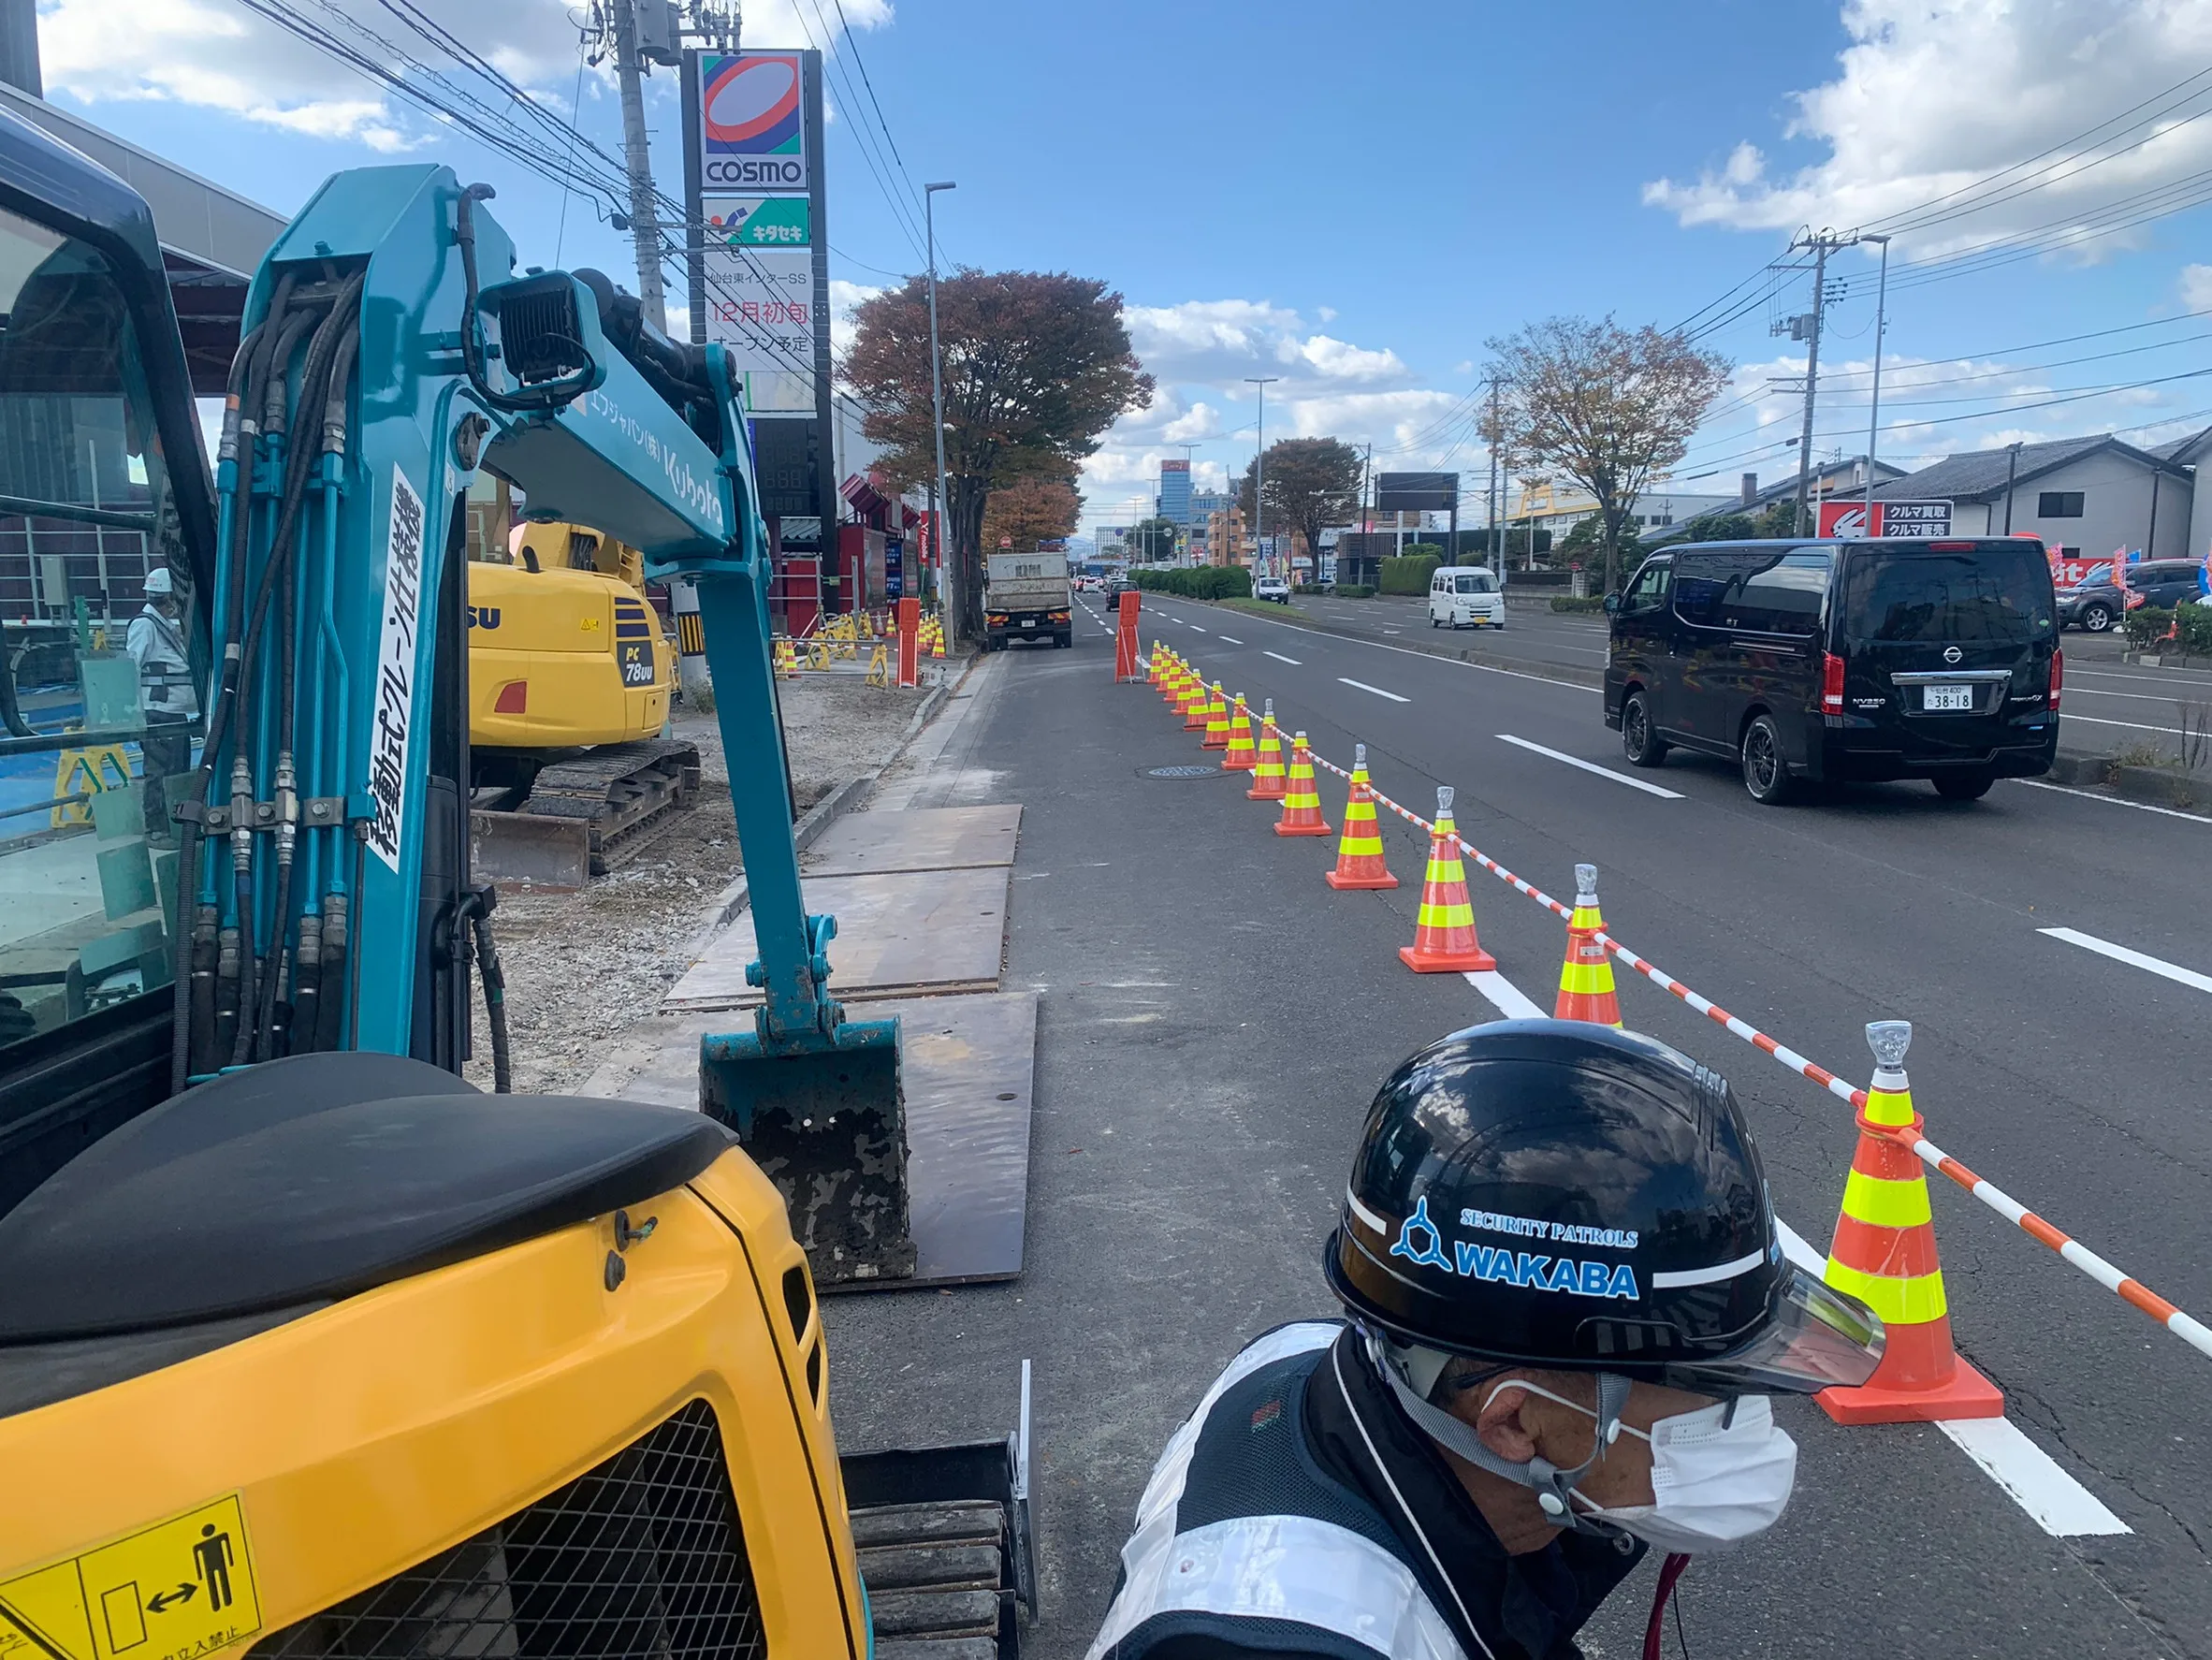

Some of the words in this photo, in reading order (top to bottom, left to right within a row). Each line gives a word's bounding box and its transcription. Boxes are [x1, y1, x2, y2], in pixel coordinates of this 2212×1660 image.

[706, 161, 802, 182] COSMO
[753, 225, 803, 241] キタセキ
[710, 272, 807, 284] 仙台東インターSS
[712, 300, 808, 325] 12月初旬
[663, 444, 723, 527] Kubota
[1890, 506, 1945, 518] クルマ買取
[1889, 524, 1945, 536] クルマ販売
[626, 647, 640, 662] PC
[367, 481, 421, 856] 移動式クレーン仕様機
[1935, 694, 1970, 708] 38-18
[1460, 1208, 1550, 1238] SECURITY
[1550, 1223, 1638, 1248] PATROLS
[1454, 1240, 1639, 1301] WAKABA
